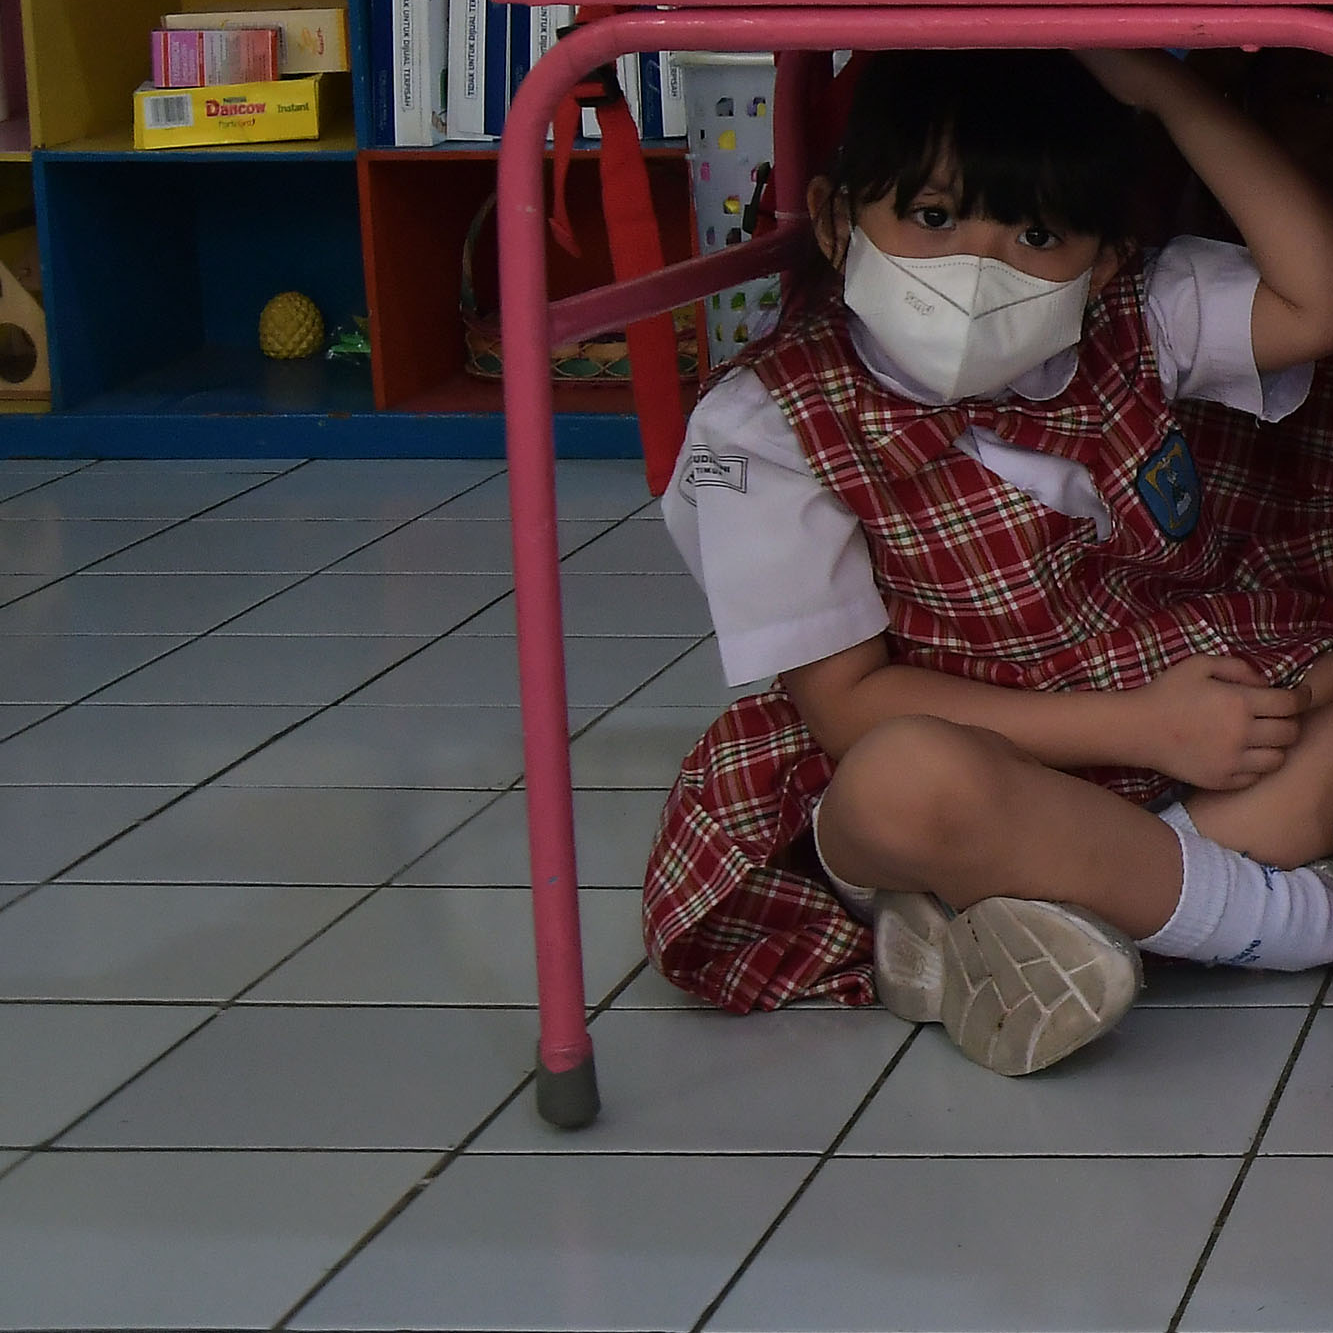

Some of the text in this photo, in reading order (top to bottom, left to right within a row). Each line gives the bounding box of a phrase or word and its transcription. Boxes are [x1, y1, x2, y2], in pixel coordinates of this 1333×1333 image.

[403, 10, 411, 38] UNTUK
[404, 68, 412, 107] TERPISAH
[277, 102, 310, 114] Instant
